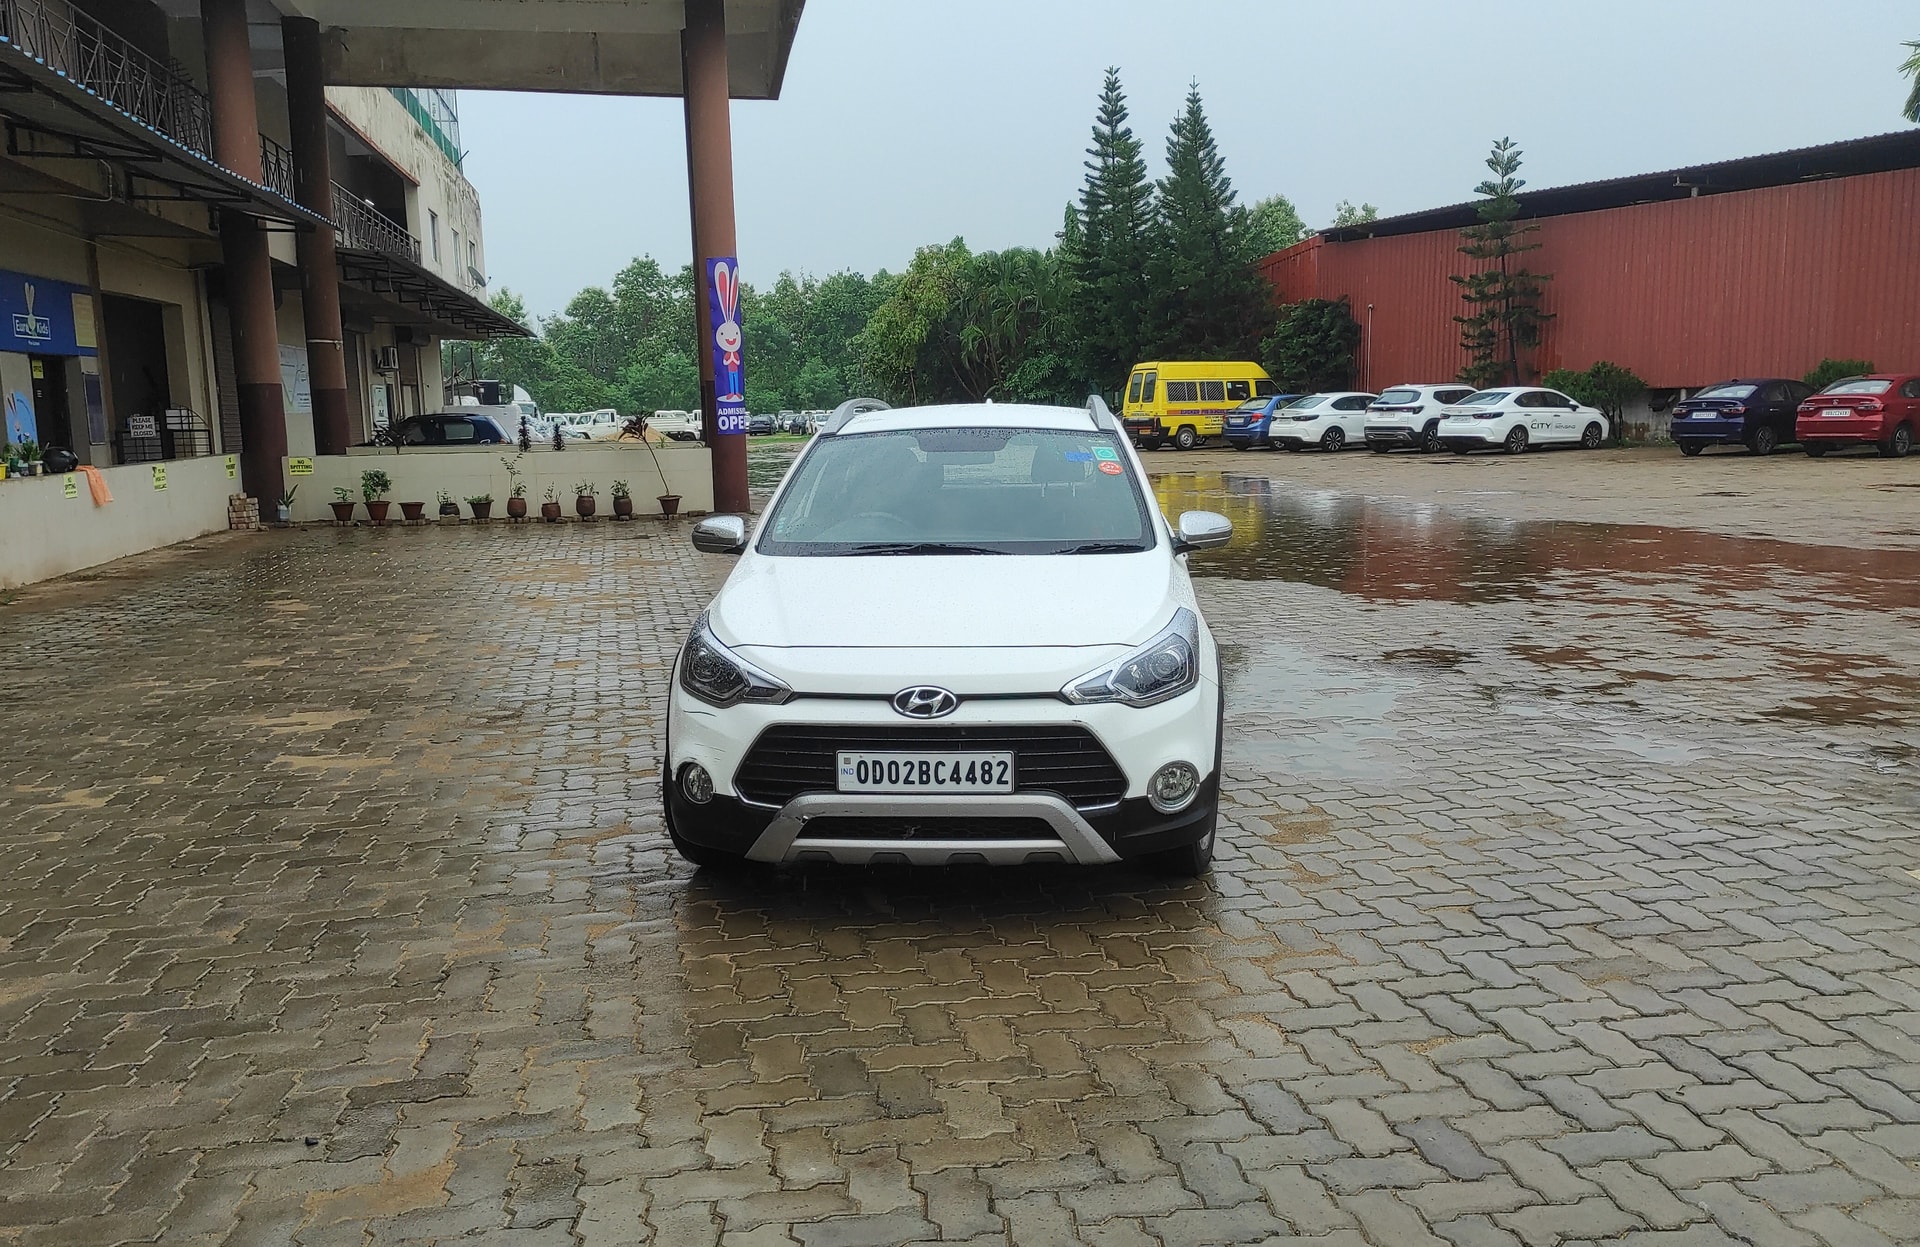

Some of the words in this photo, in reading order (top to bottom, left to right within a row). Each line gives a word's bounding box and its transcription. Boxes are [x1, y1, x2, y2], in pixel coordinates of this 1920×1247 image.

[36, 321, 49, 335] Kids
[1530, 422, 1552, 430] CITY
[840, 767, 854, 776] IND
[856, 760, 1009, 785] OD02BC4482
